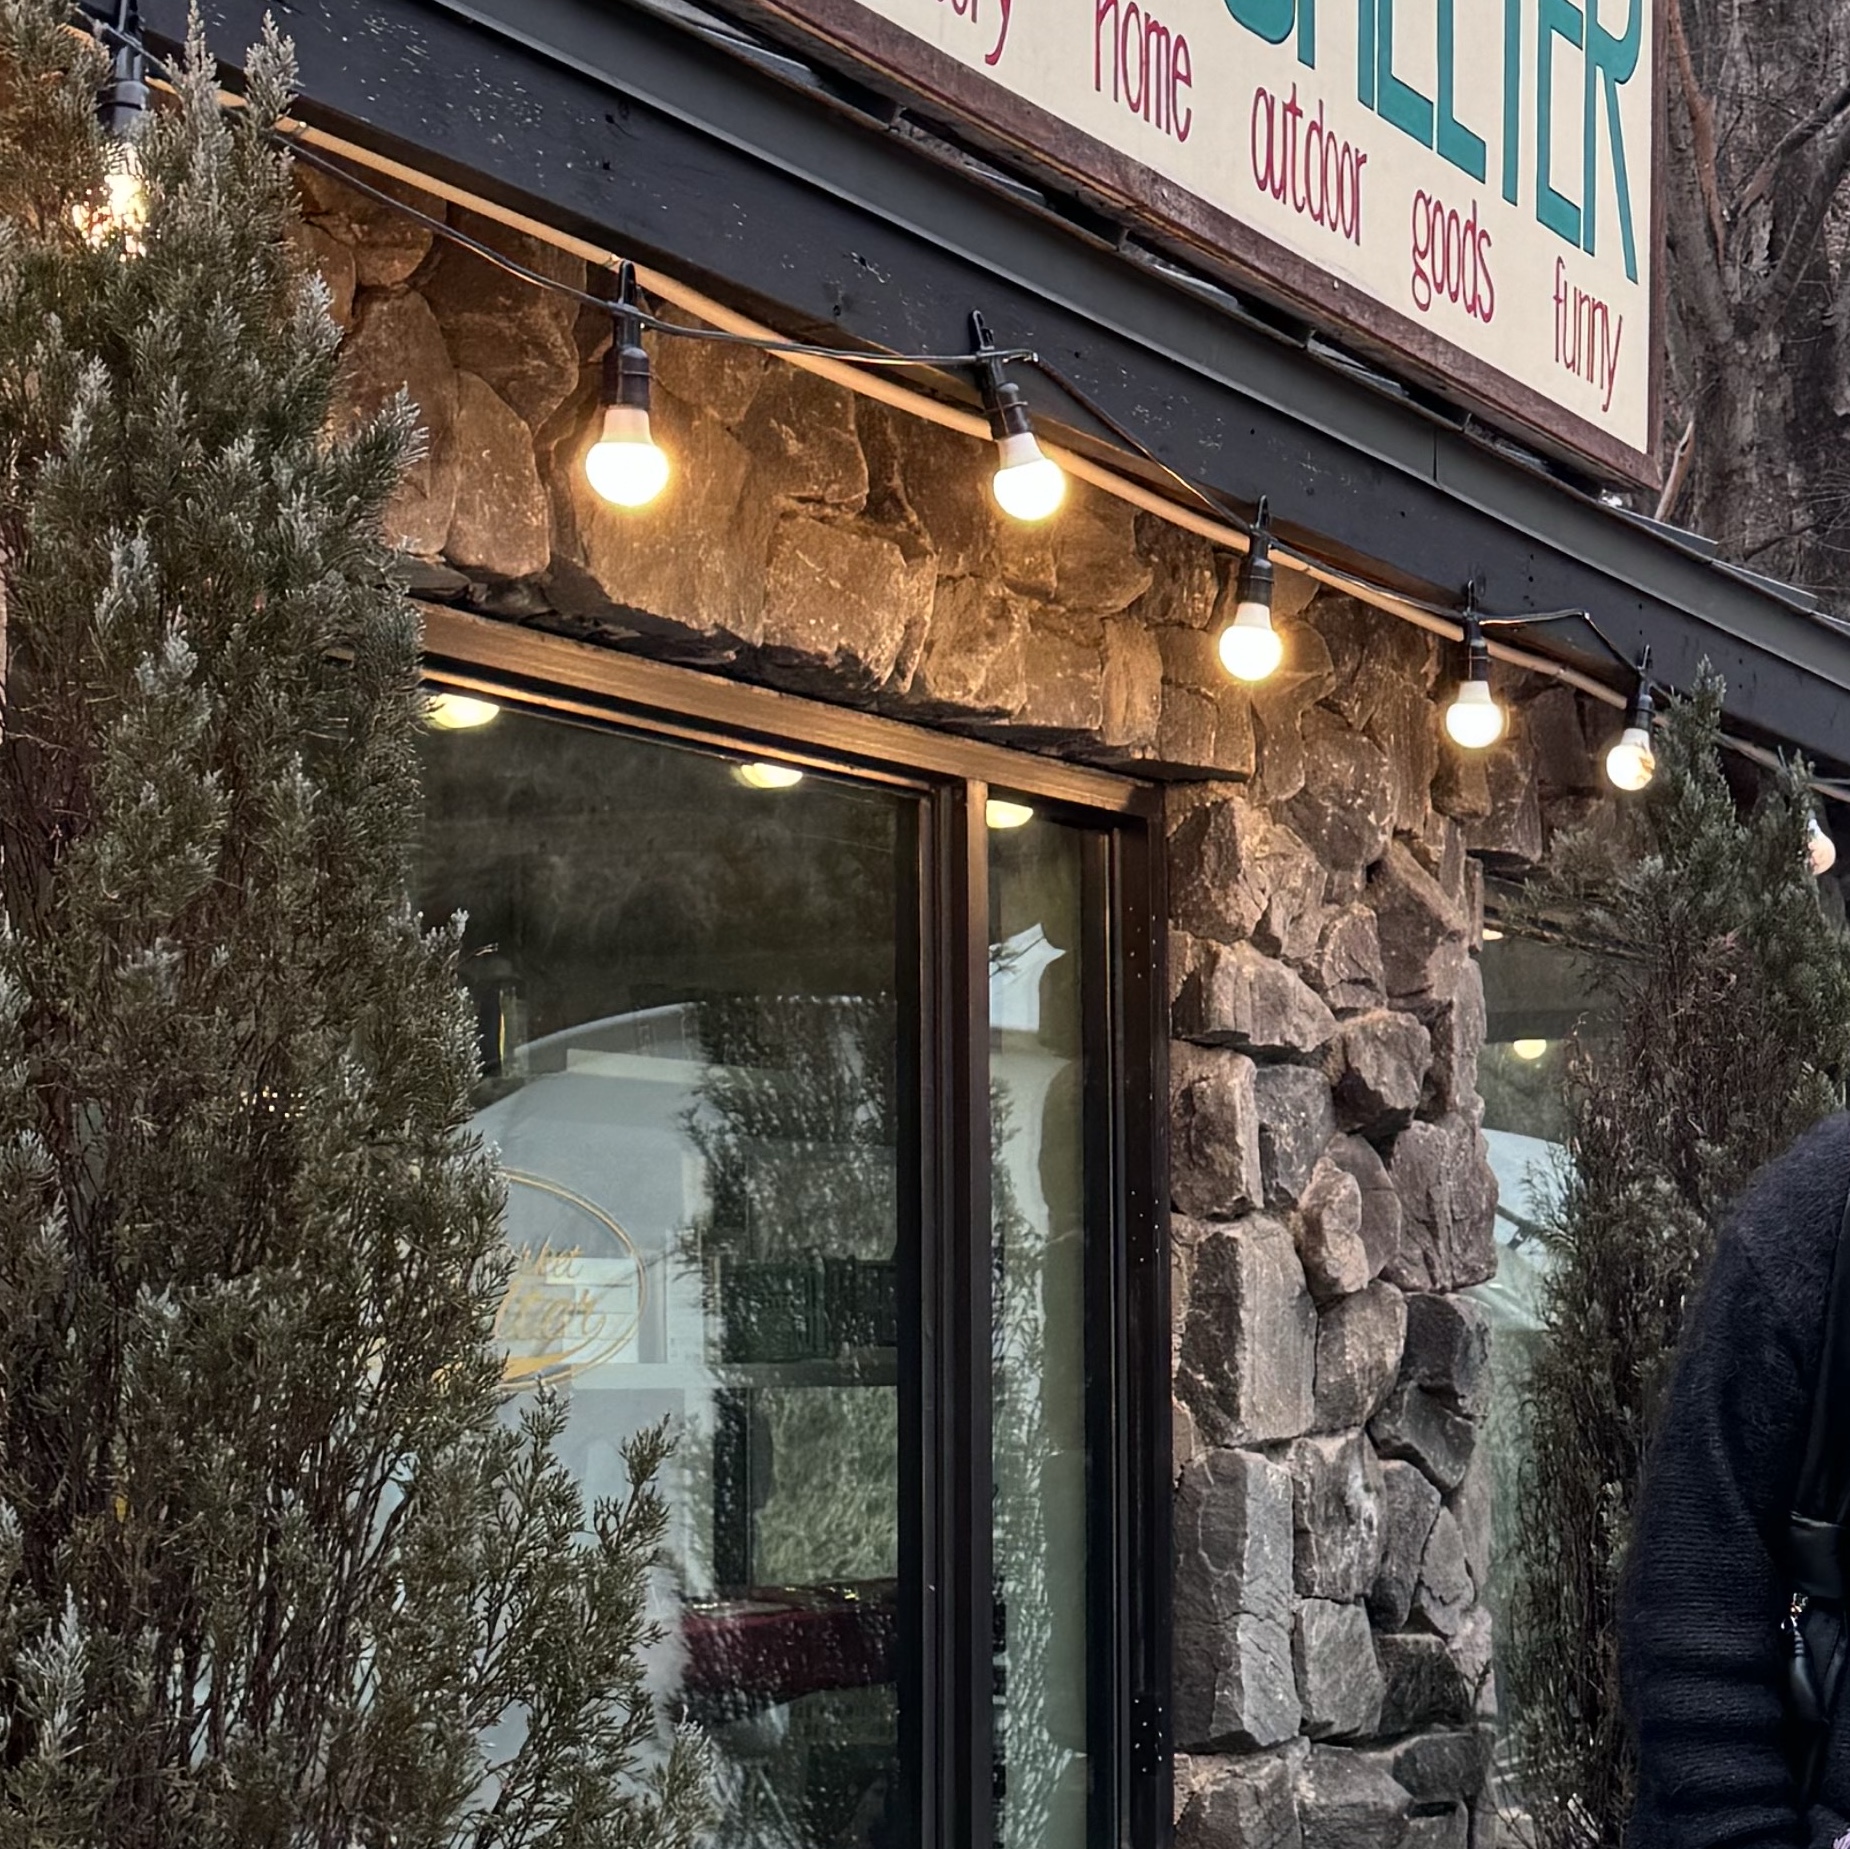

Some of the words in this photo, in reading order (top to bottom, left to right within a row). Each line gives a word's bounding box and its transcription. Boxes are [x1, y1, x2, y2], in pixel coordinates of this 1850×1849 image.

[1094, 0, 1193, 143] home
[1250, 82, 1368, 247] outdoor
[1411, 189, 1495, 324] goods
[1553, 256, 1623, 412] funny
